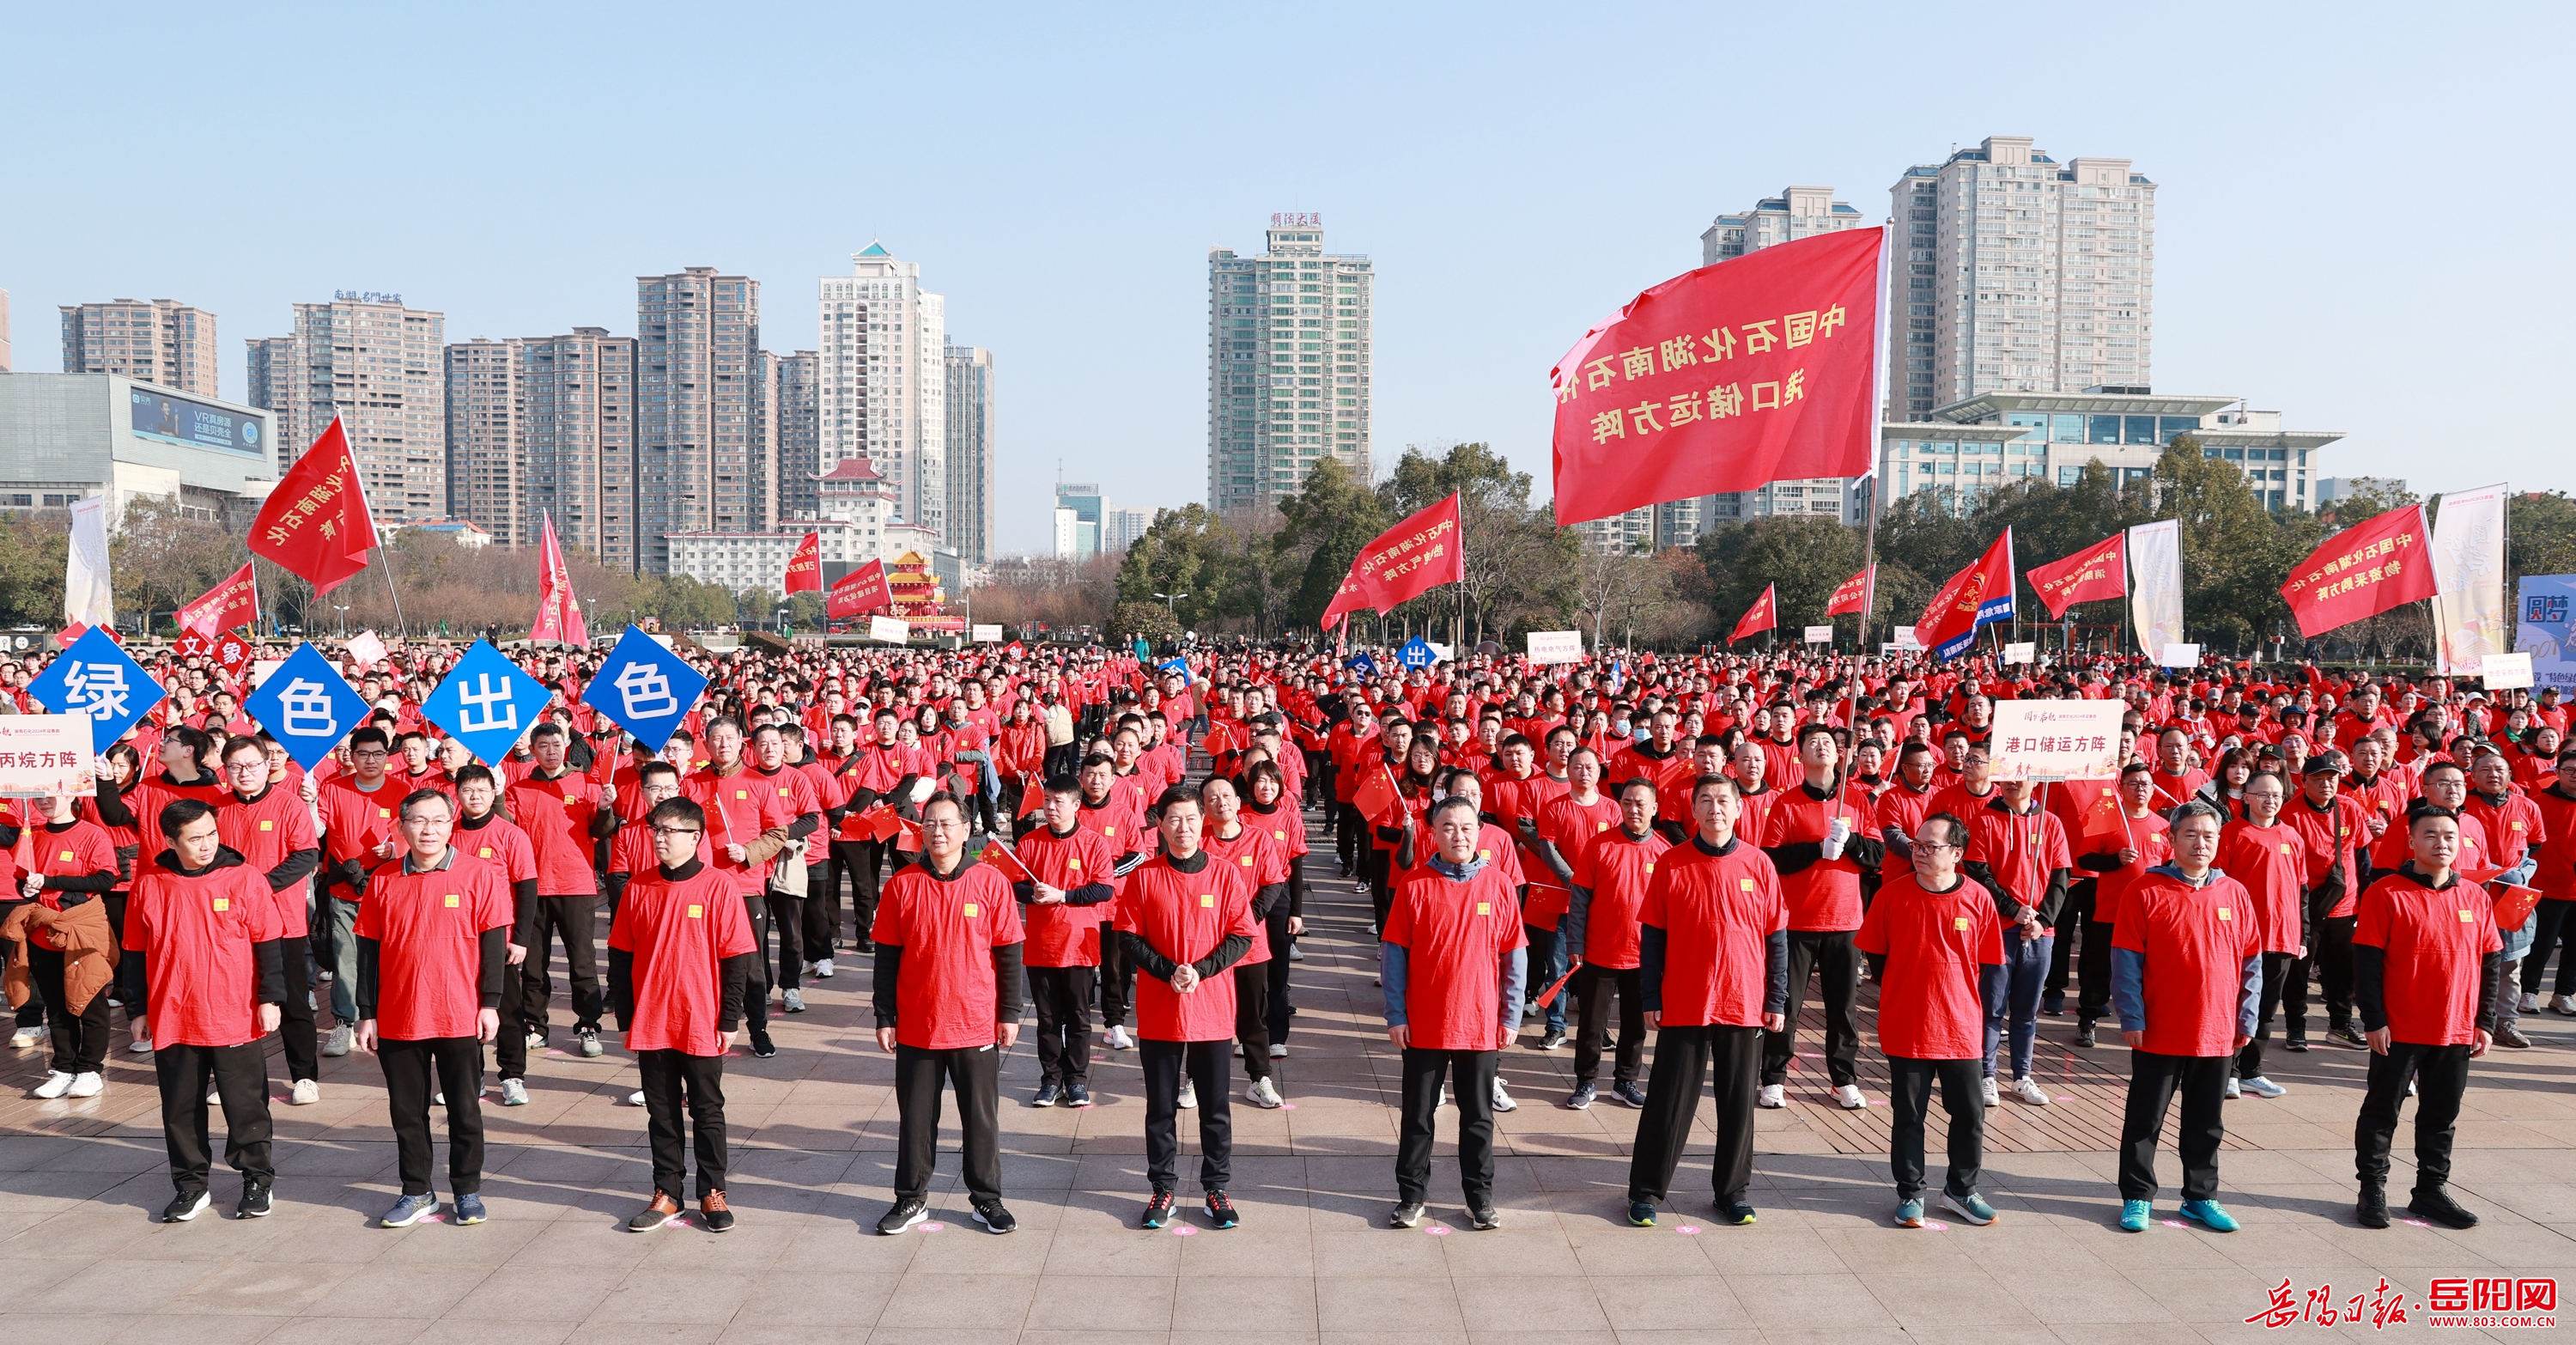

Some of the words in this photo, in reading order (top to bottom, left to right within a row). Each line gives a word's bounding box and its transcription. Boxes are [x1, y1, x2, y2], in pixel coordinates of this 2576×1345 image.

[194, 422, 232, 439] 还是贝壳全
[2526, 595, 2568, 624] 圆梦
[182, 636, 200, 656] 文
[222, 642, 243, 665] 象
[1406, 646, 1425, 666] 出
[64, 660, 131, 721] 绿
[458, 673, 518, 733] 出
[615, 662, 678, 721] 色
[279, 678, 337, 738] 色
[2005, 736, 2106, 753] 港口储运方阵
